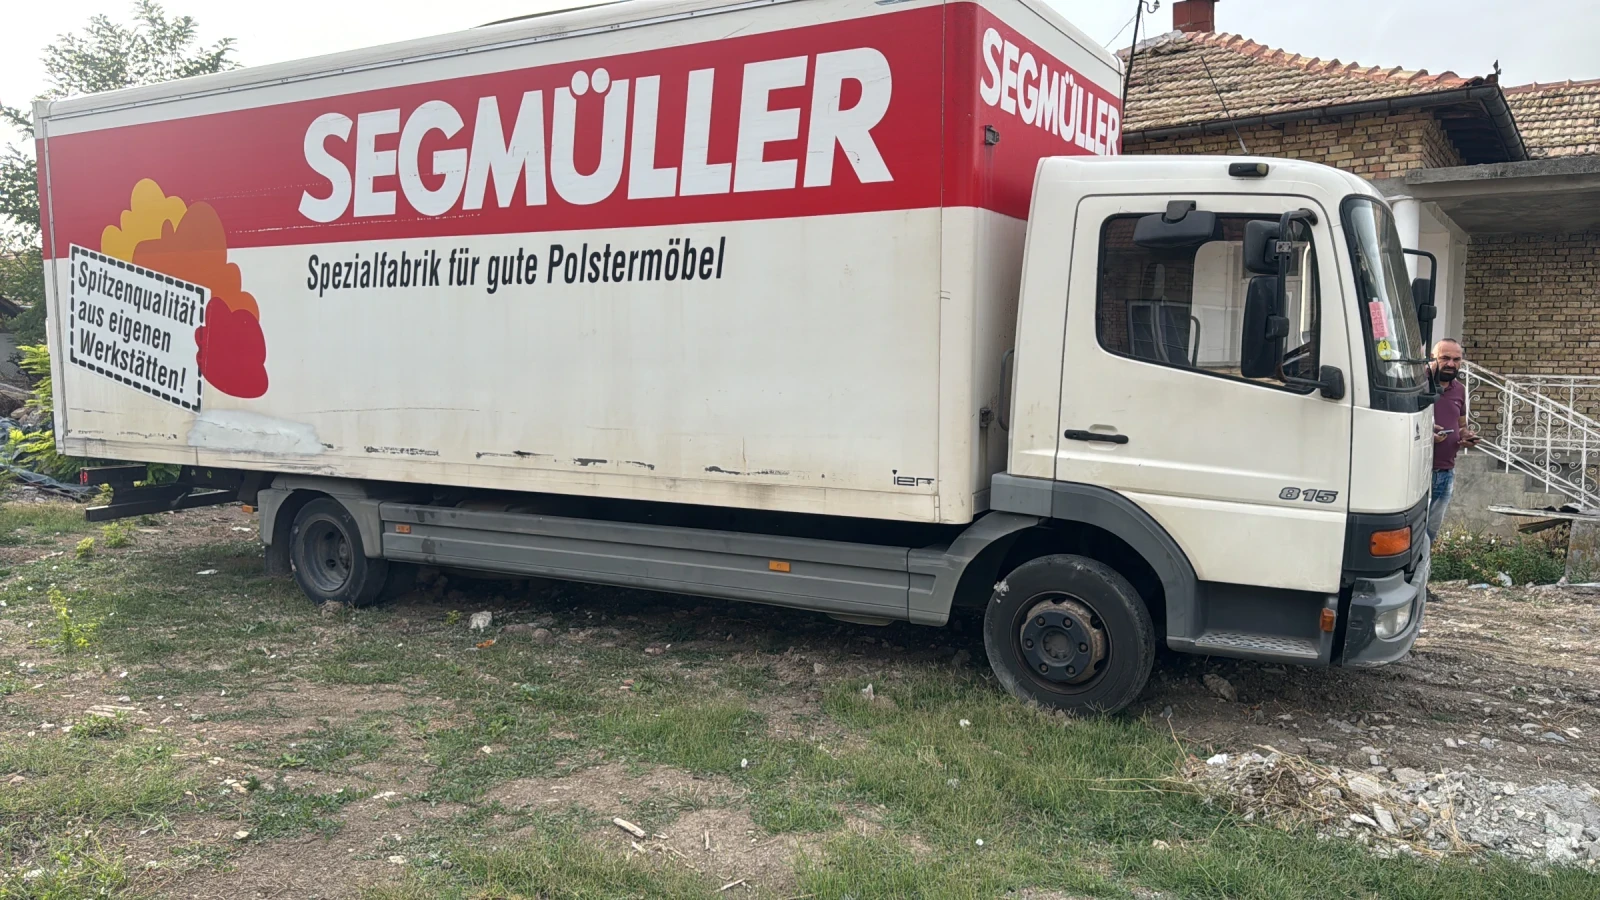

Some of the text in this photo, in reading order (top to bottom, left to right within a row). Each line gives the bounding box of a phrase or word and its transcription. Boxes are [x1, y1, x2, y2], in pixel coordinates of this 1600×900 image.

[980, 27, 1120, 156] SEGMÜLLER
[299, 46, 894, 223] SEGMÜLLER
[78, 261, 196, 327] Spitzenqualität
[307, 236, 726, 297] Spezialfabrik für gute Polstermöbel
[78, 300, 171, 353] aus eigenen
[80, 328, 187, 393] Werkstätten!
[1278, 487, 1339, 503] 815
